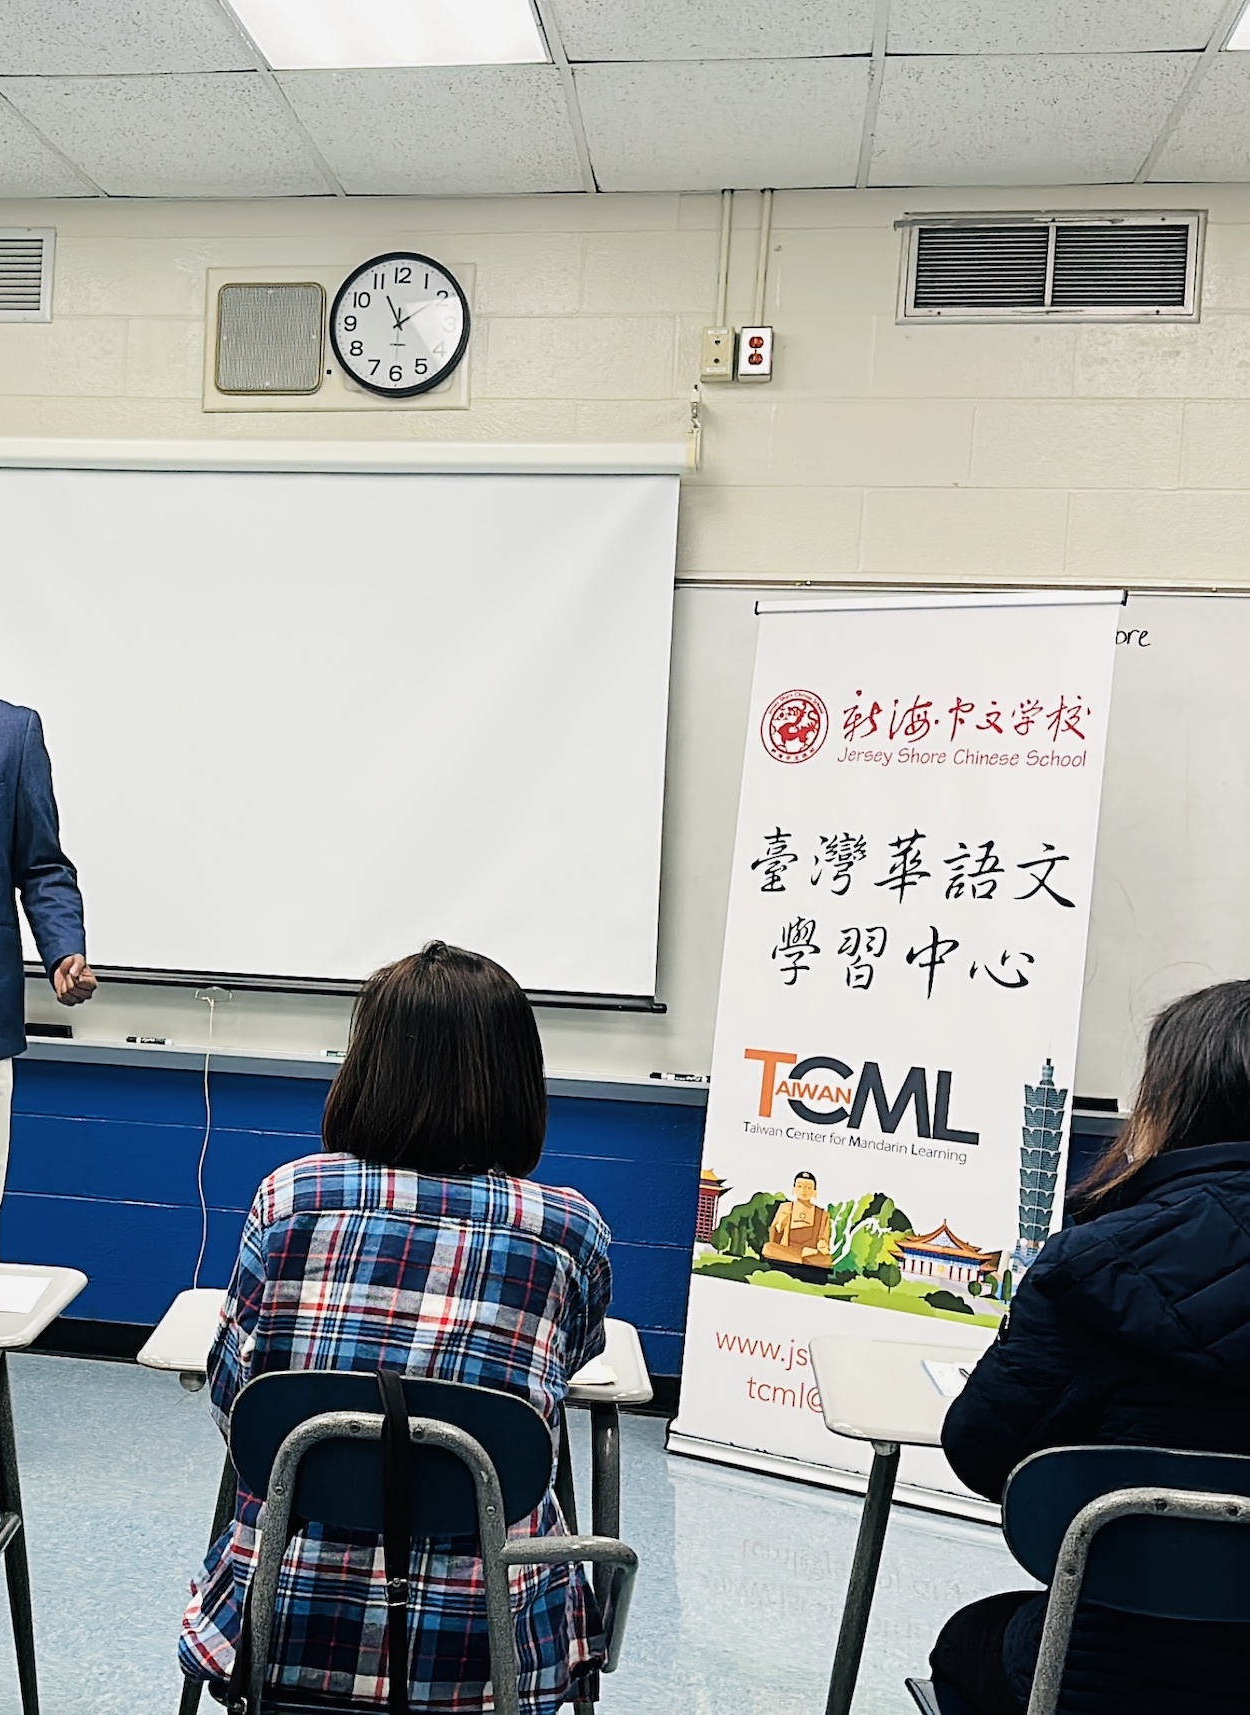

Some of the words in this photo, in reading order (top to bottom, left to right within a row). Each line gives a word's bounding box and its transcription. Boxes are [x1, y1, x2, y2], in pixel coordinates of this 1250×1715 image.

[373, 273, 385, 289] 11
[394, 267, 412, 284] 12
[353, 292, 371, 308] 10
[436, 290, 449, 307] 2
[343, 315, 357, 332] 9
[443, 316, 457, 333] 3
[349, 340, 364, 357] 8
[432, 341, 447, 358] 4
[367, 359, 381, 376] 7
[389, 365, 402, 382] 6
[414, 358, 428, 375] 5
[838, 747, 893, 767] Jersey
[897, 747, 947, 764] Shore
[953, 748, 1020, 766] Chinese
[1026, 750, 1087, 767] School
[751, 826, 1076, 908] 臺灣華語文
[771, 916, 1035, 1000] 學習中心
[743, 1121, 783, 1138] Taiwan
[785, 1127, 826, 1143] Center
[829, 1132, 847, 1145] for
[849, 1135, 908, 1154] Mandarin
[911, 1143, 968, 1165] Learning
